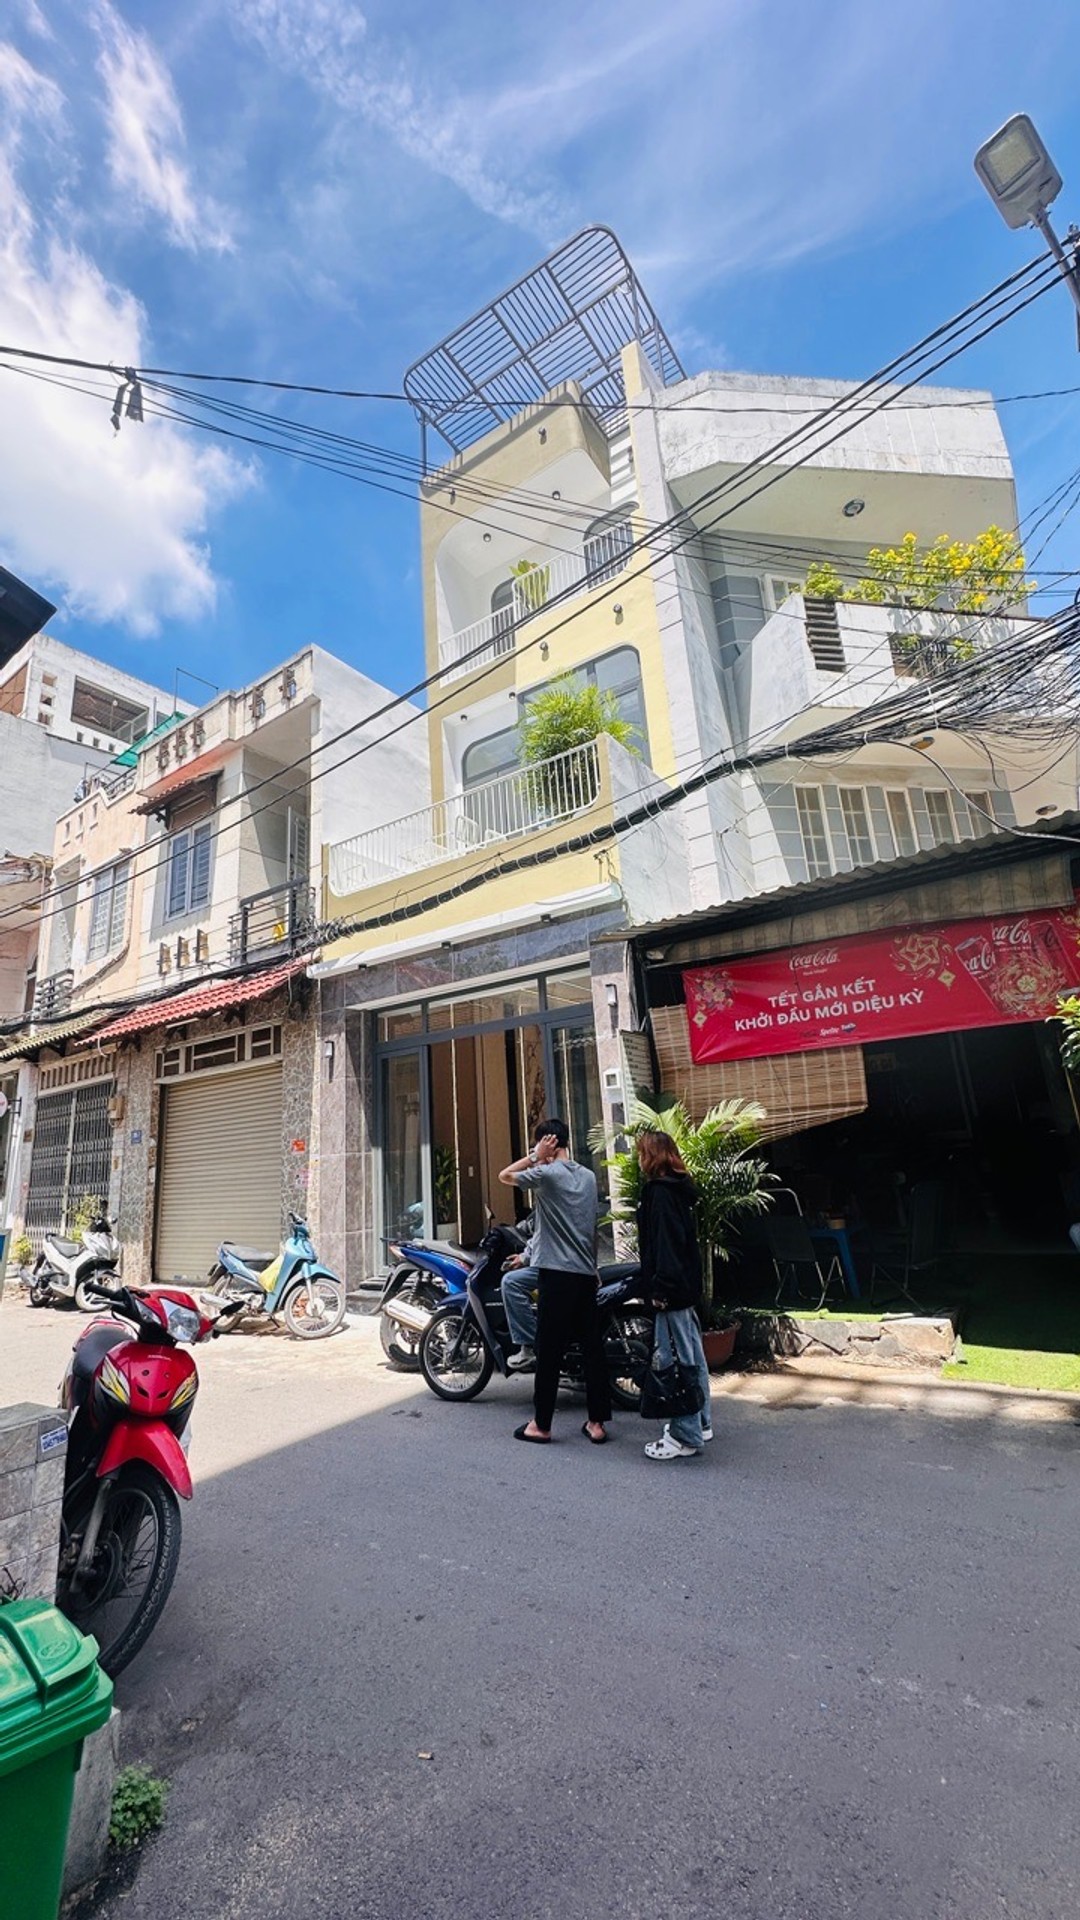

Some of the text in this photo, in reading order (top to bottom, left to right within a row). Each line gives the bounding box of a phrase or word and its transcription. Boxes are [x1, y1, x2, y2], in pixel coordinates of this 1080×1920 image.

[735, 988, 924, 1031] KHỞI ĐẦU MỚI DIỆU KỲ
[768, 976, 876, 1008] TẾT GẮN KẾT
